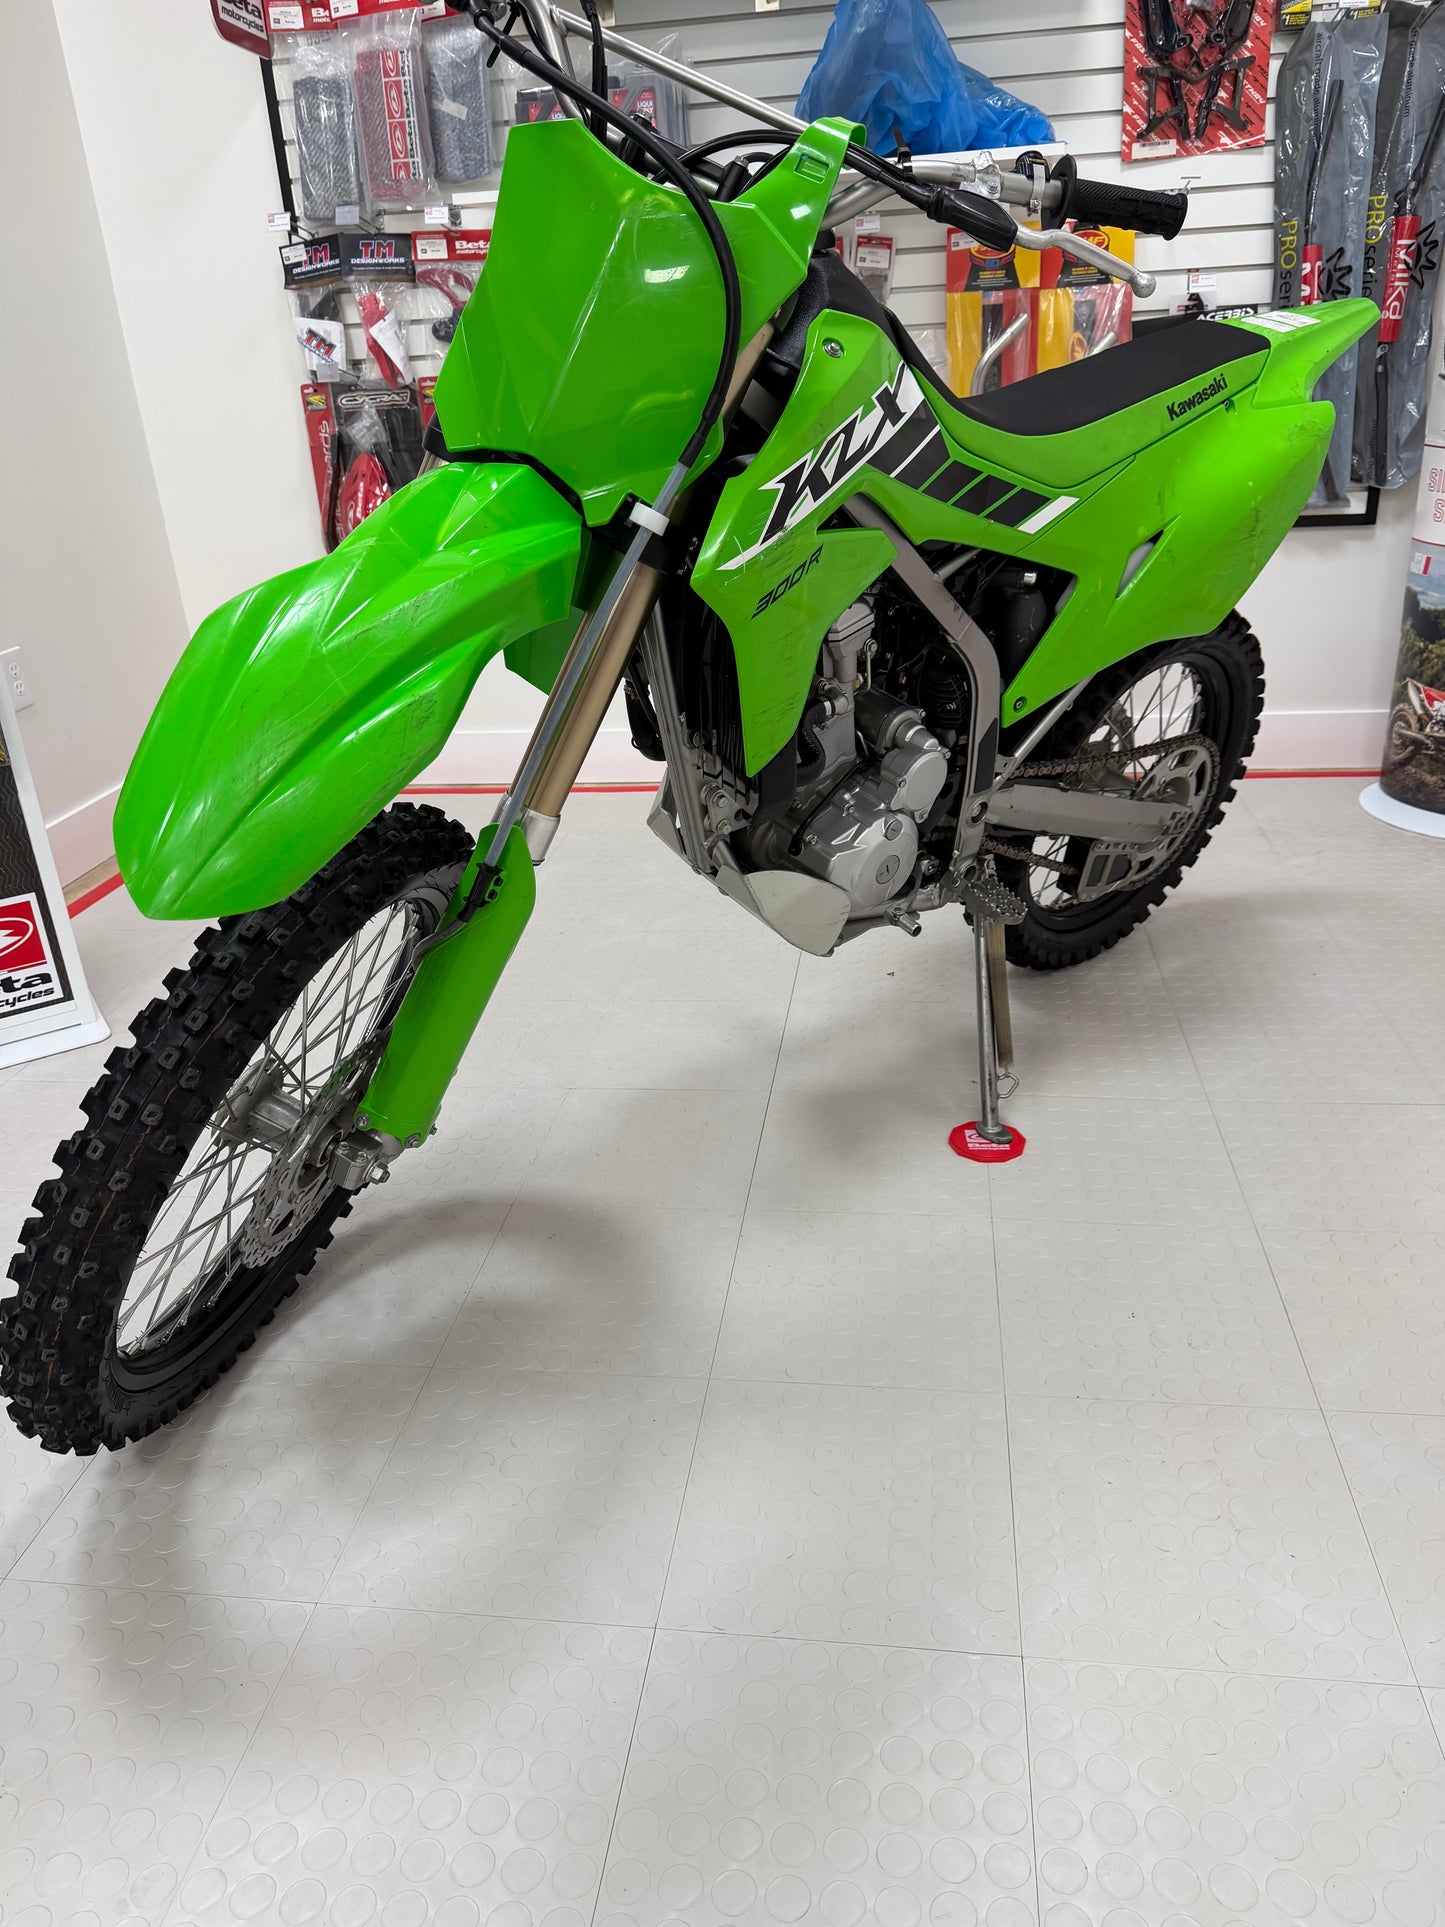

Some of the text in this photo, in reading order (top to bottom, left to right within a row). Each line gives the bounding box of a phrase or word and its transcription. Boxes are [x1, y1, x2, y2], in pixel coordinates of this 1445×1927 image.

[221, 6, 264, 33] motorcycles
[1366, 195, 1387, 244] PRO
[360, 240, 395, 258] TM
[1281, 220, 1298, 269] PRO
[292, 259, 340, 274] DESIGNWORKS
[1197, 307, 1255, 321] ACERBIS
[1166, 372, 1228, 421] Kawasaki
[751, 543, 824, 620] 300R
